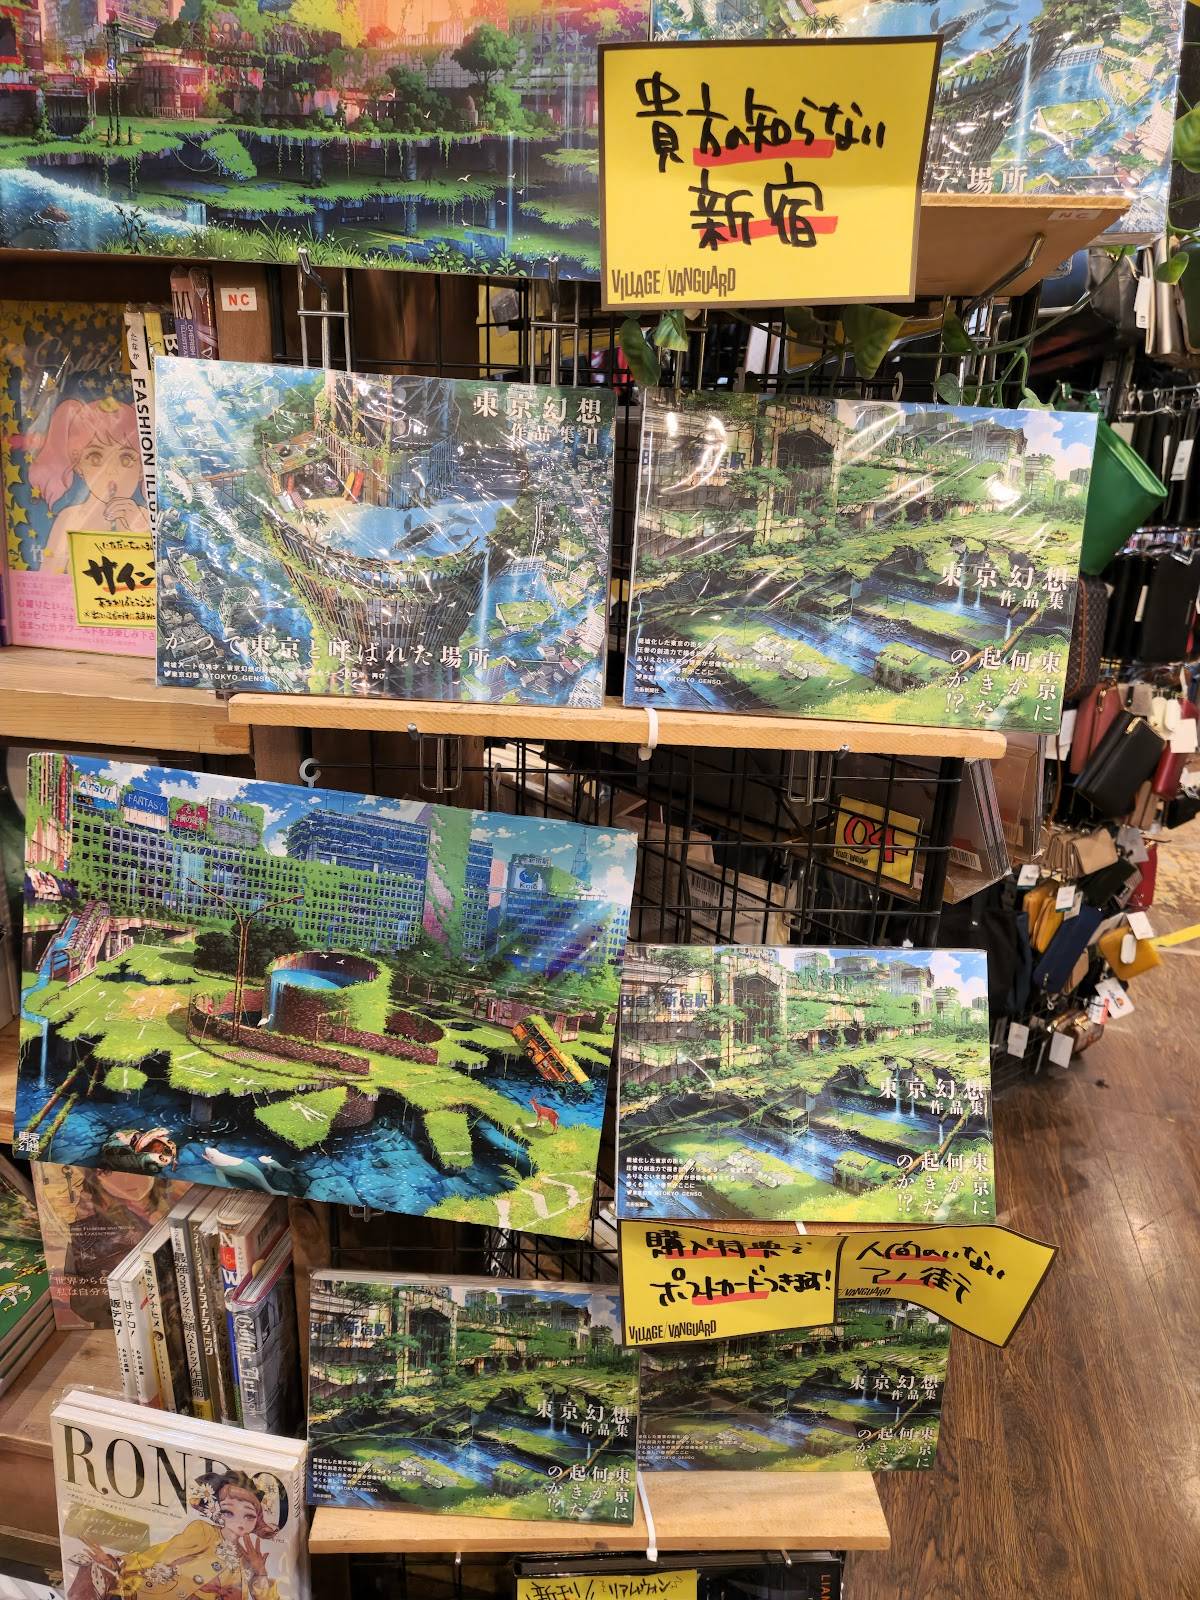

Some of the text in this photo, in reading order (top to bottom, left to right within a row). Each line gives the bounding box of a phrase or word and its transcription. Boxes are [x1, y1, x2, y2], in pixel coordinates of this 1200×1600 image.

[635, 71, 886, 173] 貴方の知らない
[688, 161, 824, 251] 新宿
[228, 293, 250, 306] NC
[134, 378, 155, 466] FASHION
[473, 389, 601, 424] 東京幻想
[938, 564, 1069, 592] 東京幻想
[1000, 592, 1064, 610] 作品集
[975, 649, 1002, 719] 起きた
[1009, 650, 1033, 695] 何が
[1034, 651, 1062, 721] 東京に
[879, 1077, 984, 1101] 東京幻想
[931, 1099, 984, 1116] 作品集
[920, 1153, 940, 1216] 起きた
[946, 1153, 965, 1193] 何が
[972, 1154, 990, 1215] 東京に
[849, 1374, 938, 1390] 東京幻想
[892, 1389, 936, 1401] 作品集
[535, 1401, 629, 1425] 東京幻想
[580, 1422, 629, 1438] 作品集
[897, 1427, 914, 1454] 何が
[917, 1427, 935, 1468] 東京に
[569, 1464, 588, 1517] 起きた
[592, 1466, 609, 1500] 何が
[613, 1468, 631, 1519] 東京に
